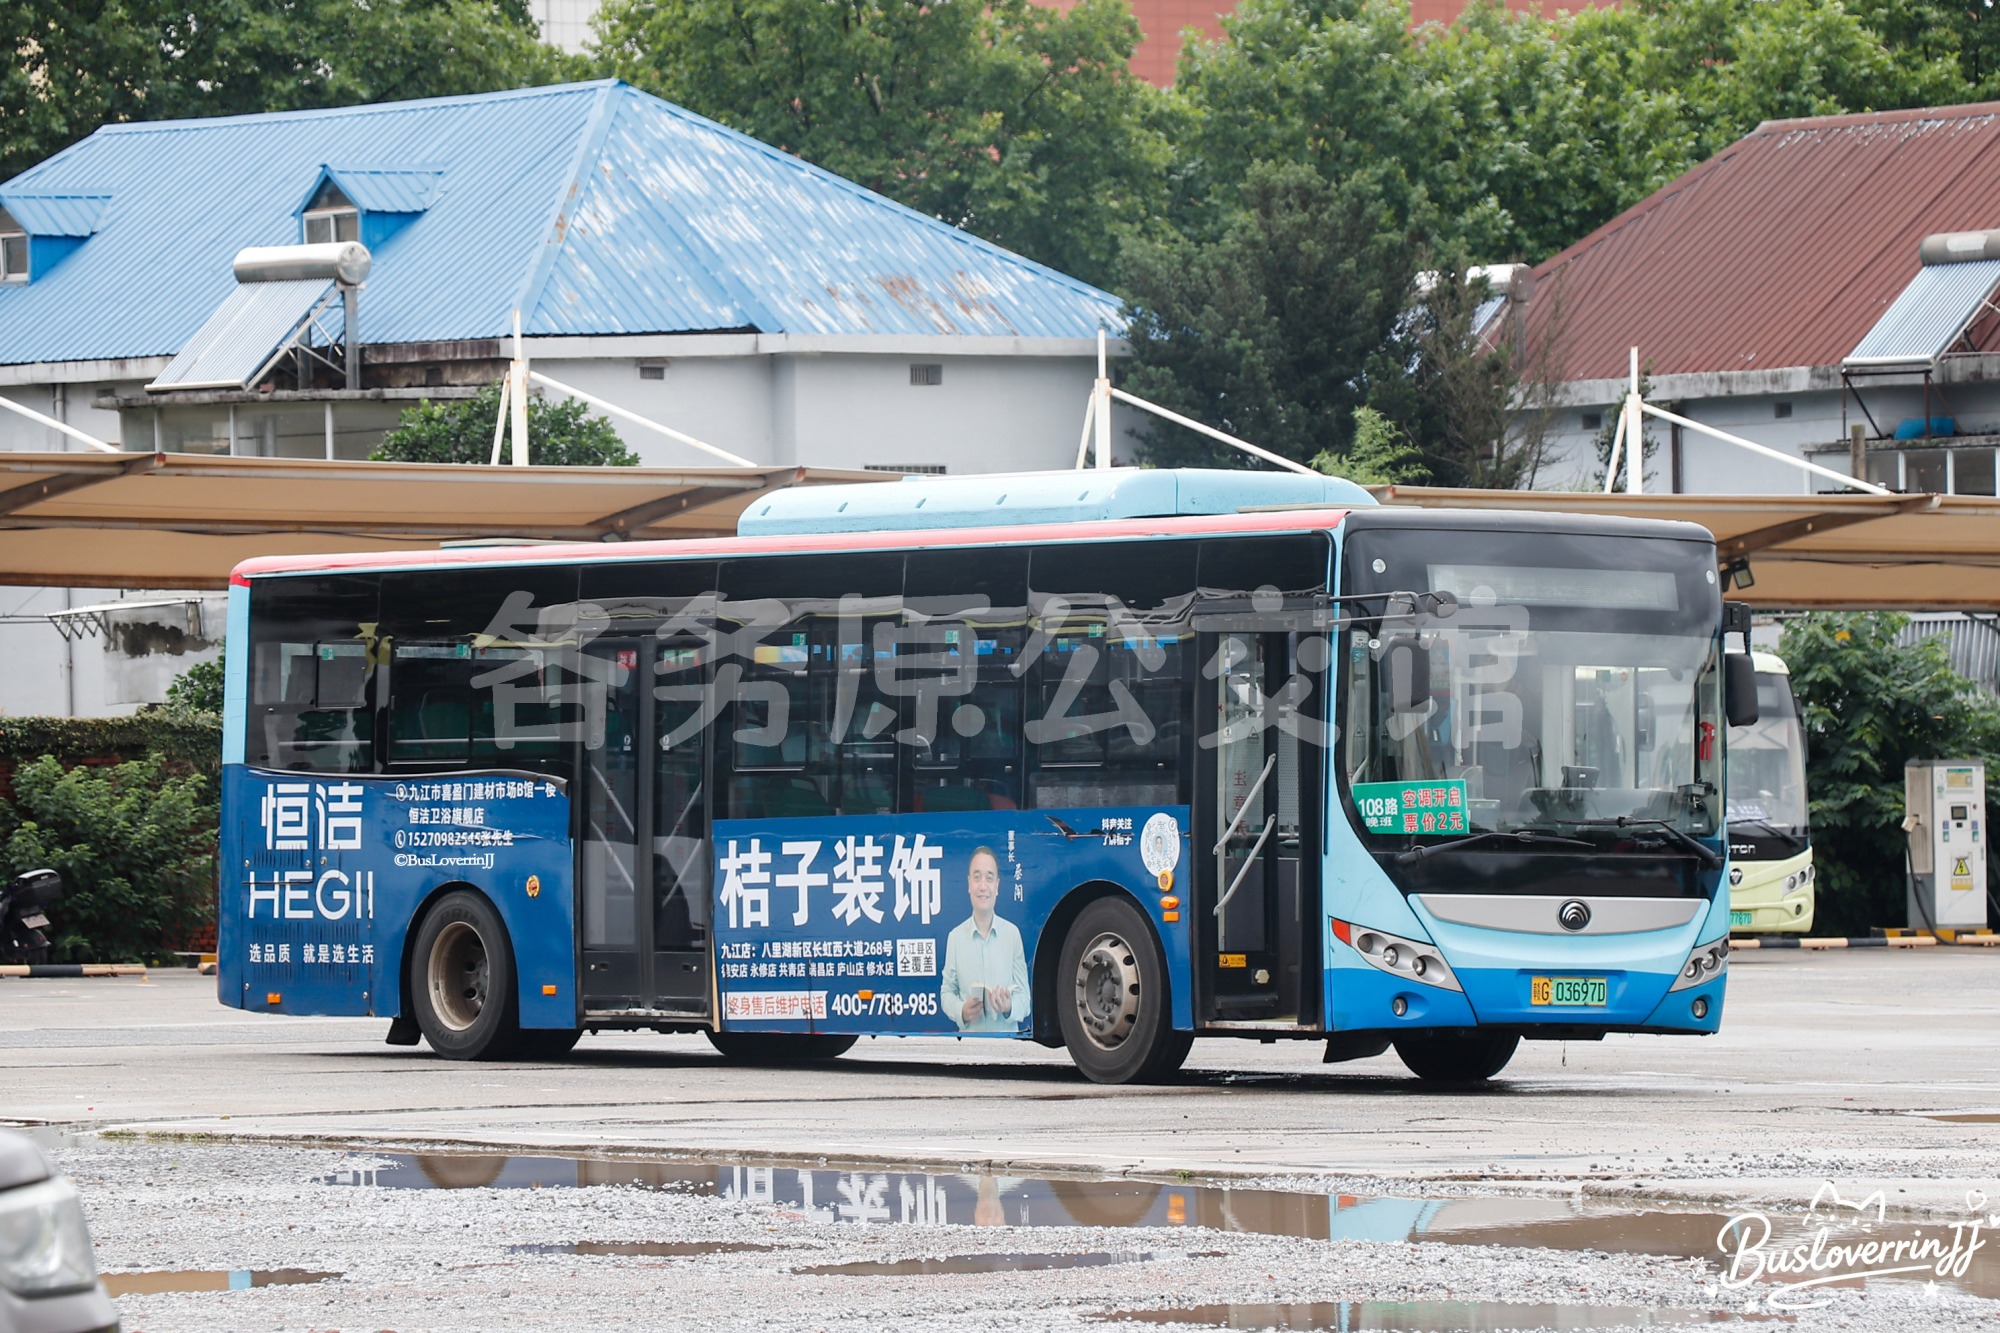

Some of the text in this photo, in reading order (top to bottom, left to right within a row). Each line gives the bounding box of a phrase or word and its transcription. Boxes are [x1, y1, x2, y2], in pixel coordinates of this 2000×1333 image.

[1358, 797, 1399, 816] 108路
[1402, 787, 1461, 808] 空调开启
[262, 782, 364, 850] 恒洁
[408, 807, 485, 825] 恒洁卫浴旗舰店
[1101, 817, 1133, 831] 抖音关注
[1366, 816, 1393, 827] 晚班
[1403, 811, 1464, 833] 票价2元
[719, 834, 943, 928] 桔子装饰
[248, 869, 373, 920] HEGII
[249, 943, 374, 964] 选品质 就是选生活
[899, 942, 934, 955] 九江县区
[750, 963, 777, 978] 永修店
[779, 962, 806, 977] 共青店
[837, 962, 865, 977] 庐山店
[866, 961, 894, 976] 修水店
[900, 956, 934, 973] 全覆盖
[728, 995, 824, 1015] 终身售后维护电话
